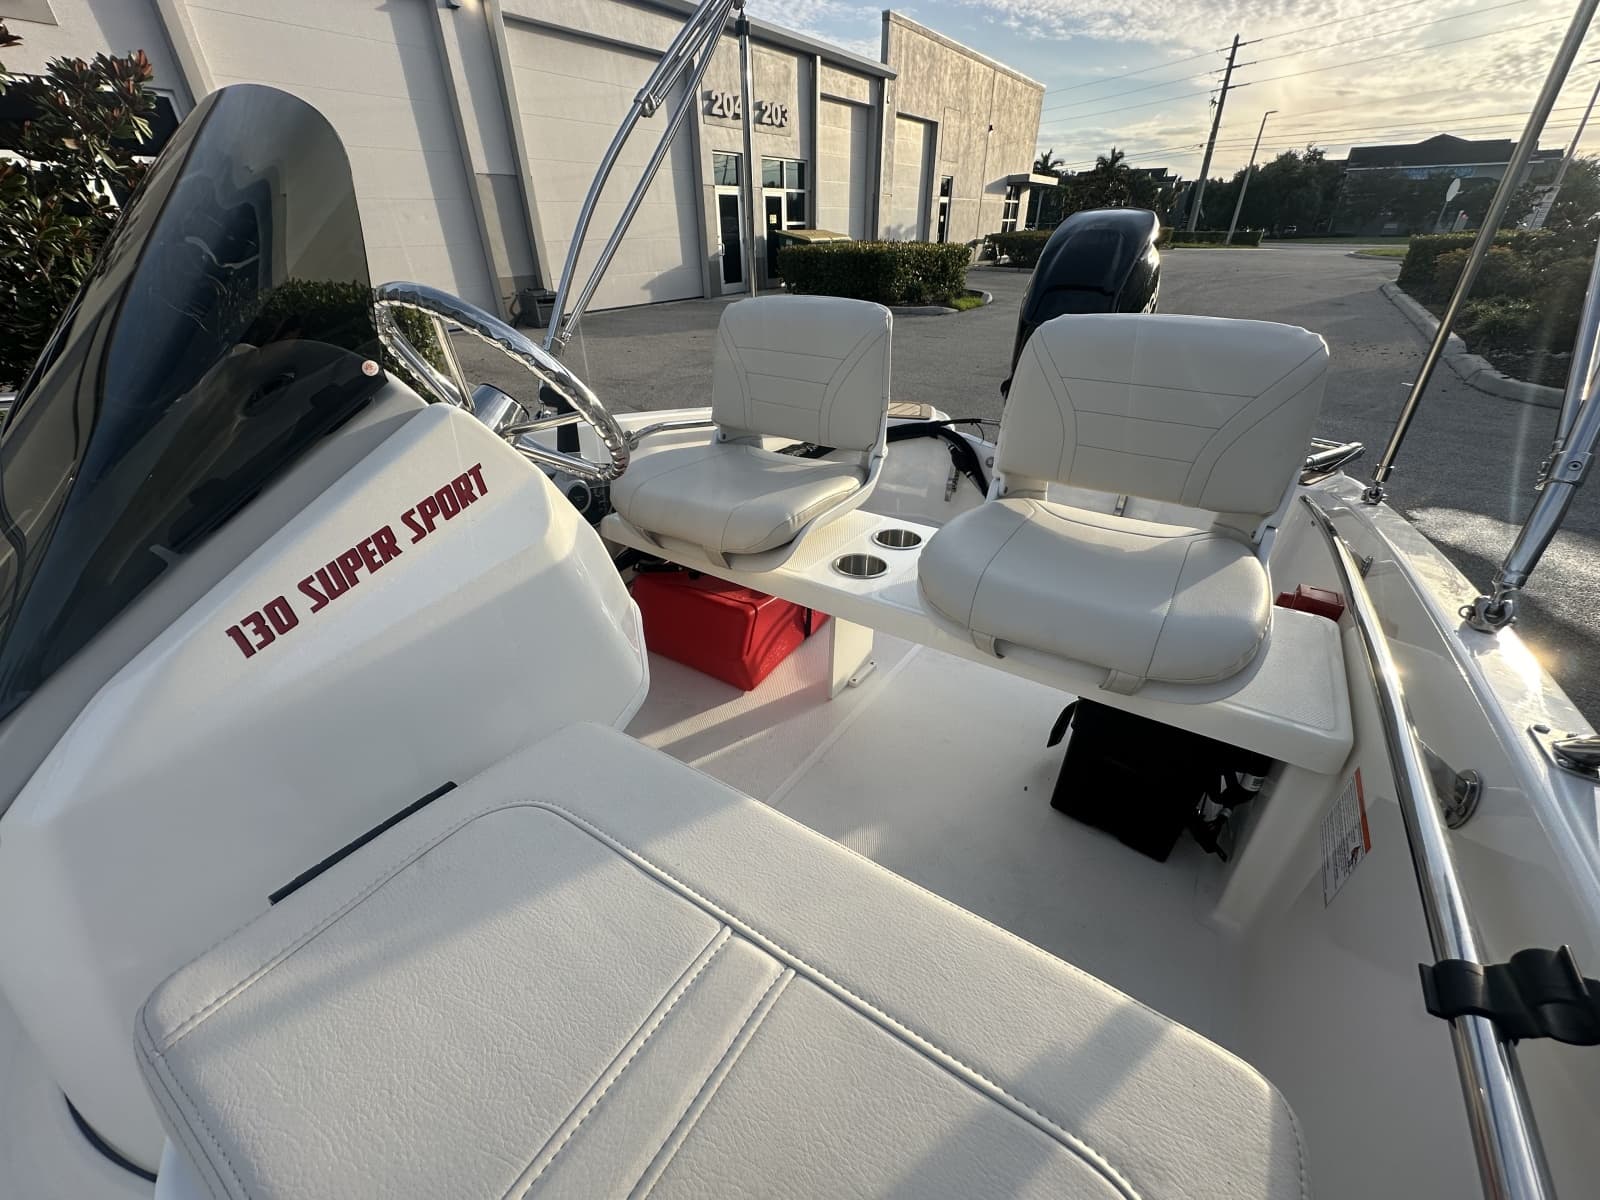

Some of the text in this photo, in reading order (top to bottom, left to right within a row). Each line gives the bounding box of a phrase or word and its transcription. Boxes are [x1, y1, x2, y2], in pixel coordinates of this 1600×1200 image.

[761, 102, 788, 126] 203
[225, 463, 489, 659] 130 SUPER SPORT
